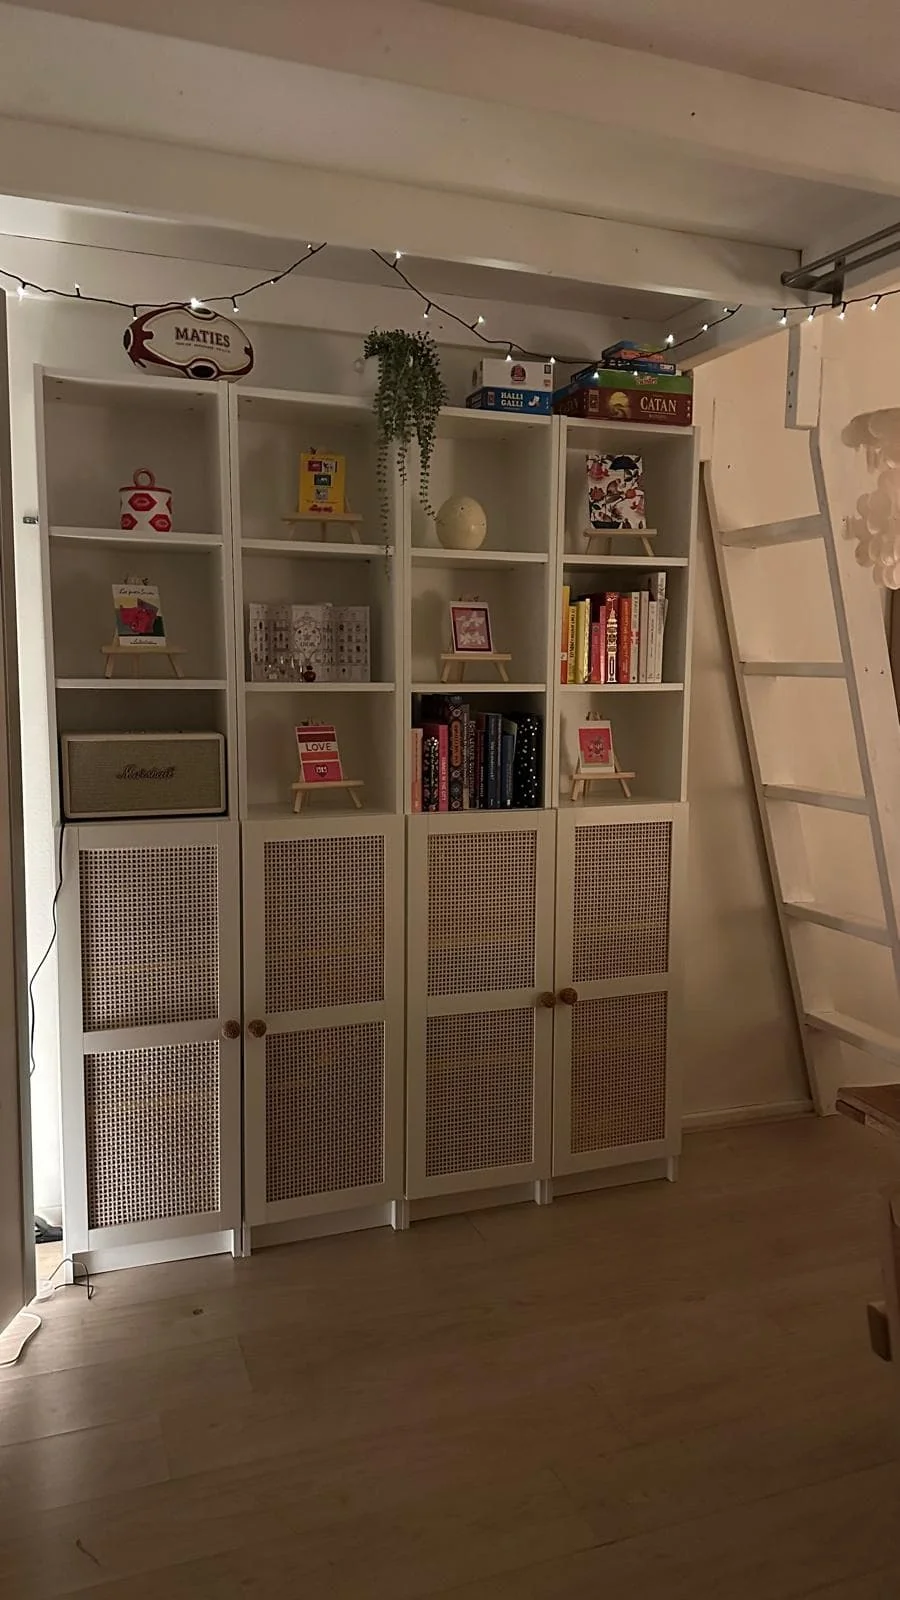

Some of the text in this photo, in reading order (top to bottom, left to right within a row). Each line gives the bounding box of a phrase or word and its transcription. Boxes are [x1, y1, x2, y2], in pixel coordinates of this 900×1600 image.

[175, 326, 231, 348] MATIES
[501, 391, 523, 400] HALLI
[501, 399, 523, 407] GALLI
[640, 396, 677, 413] CATAN
[305, 743, 332, 752] LOVE
